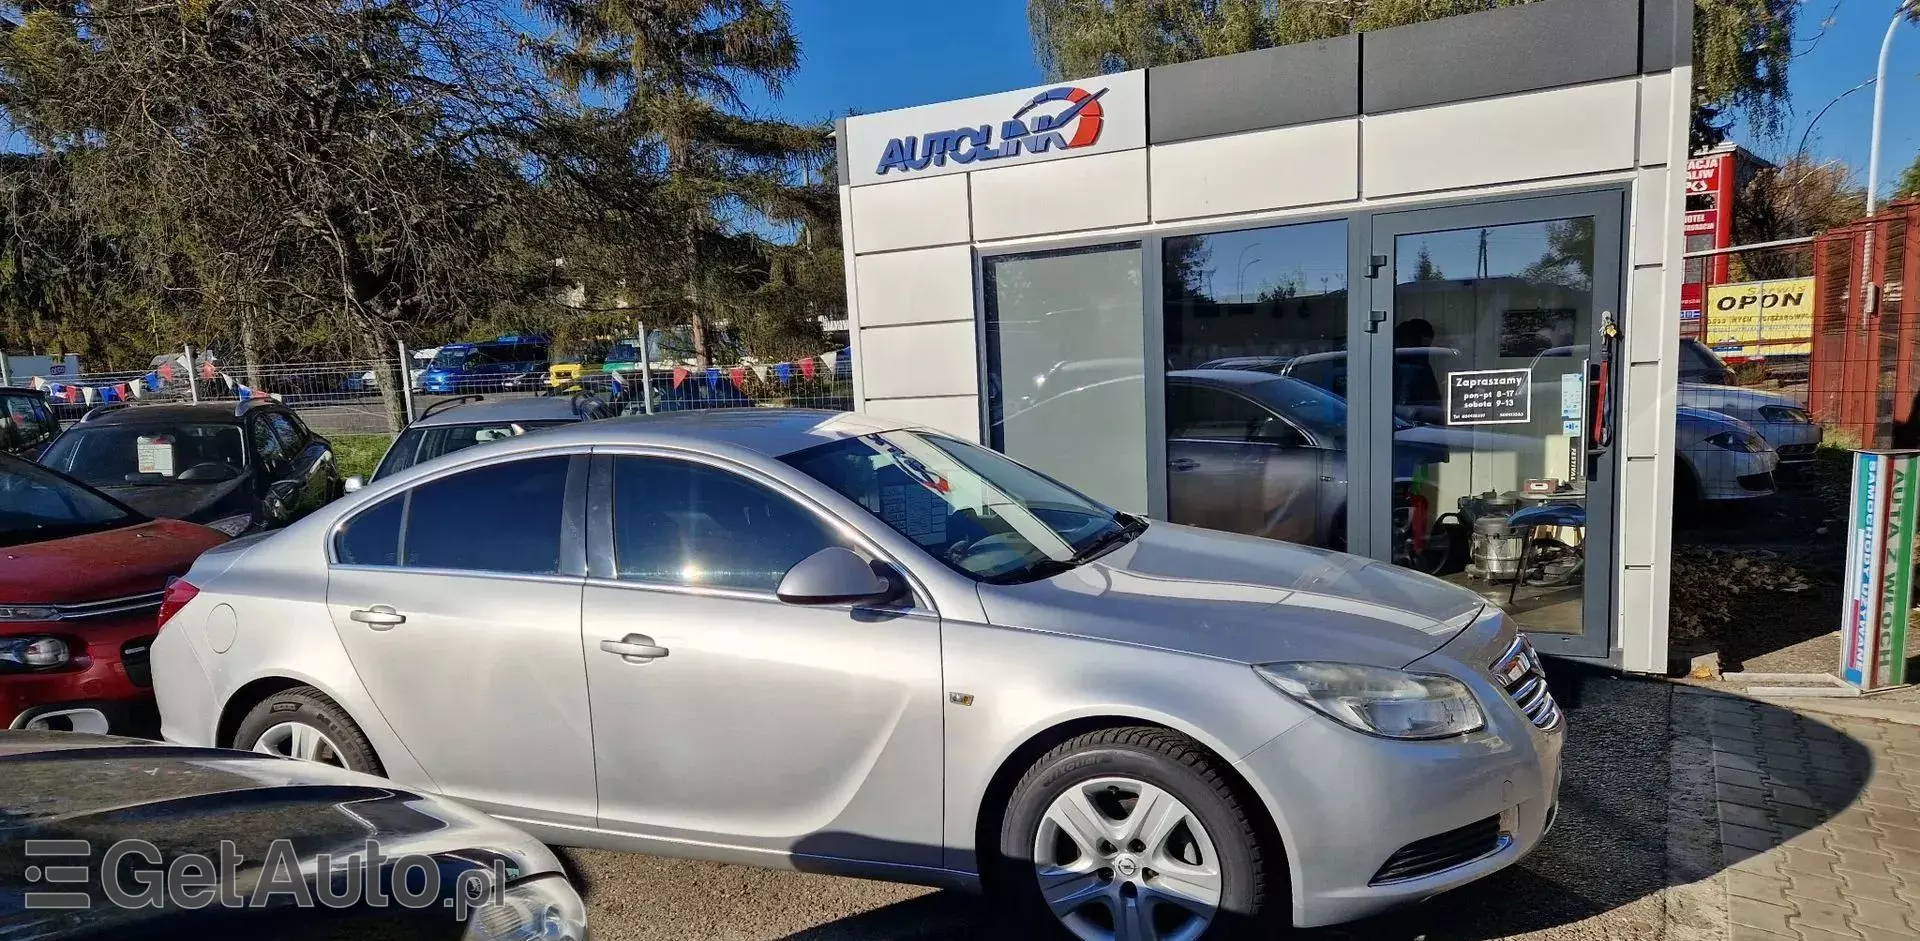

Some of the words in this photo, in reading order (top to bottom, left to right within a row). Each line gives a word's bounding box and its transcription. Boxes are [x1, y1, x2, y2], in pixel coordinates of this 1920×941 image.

[875, 113, 1070, 176] AUTOLINK
[1687, 158, 1718, 170] ACJA
[1686, 168, 1714, 180] ALIW
[1717, 293, 1804, 311] OPON
[1456, 376, 1522, 389] Zapraszamy
[1463, 391, 1493, 401] pon-pt
[1496, 390, 1514, 398] 8-17
[1464, 401, 1492, 409] sobota
[1495, 399, 1514, 407] 9-13
[1887, 468, 1905, 540] AUTA
[1864, 460, 1876, 578] SAMOCHODY
[1885, 547, 1897, 566] Z
[1879, 573, 1897, 667] WŁOCH
